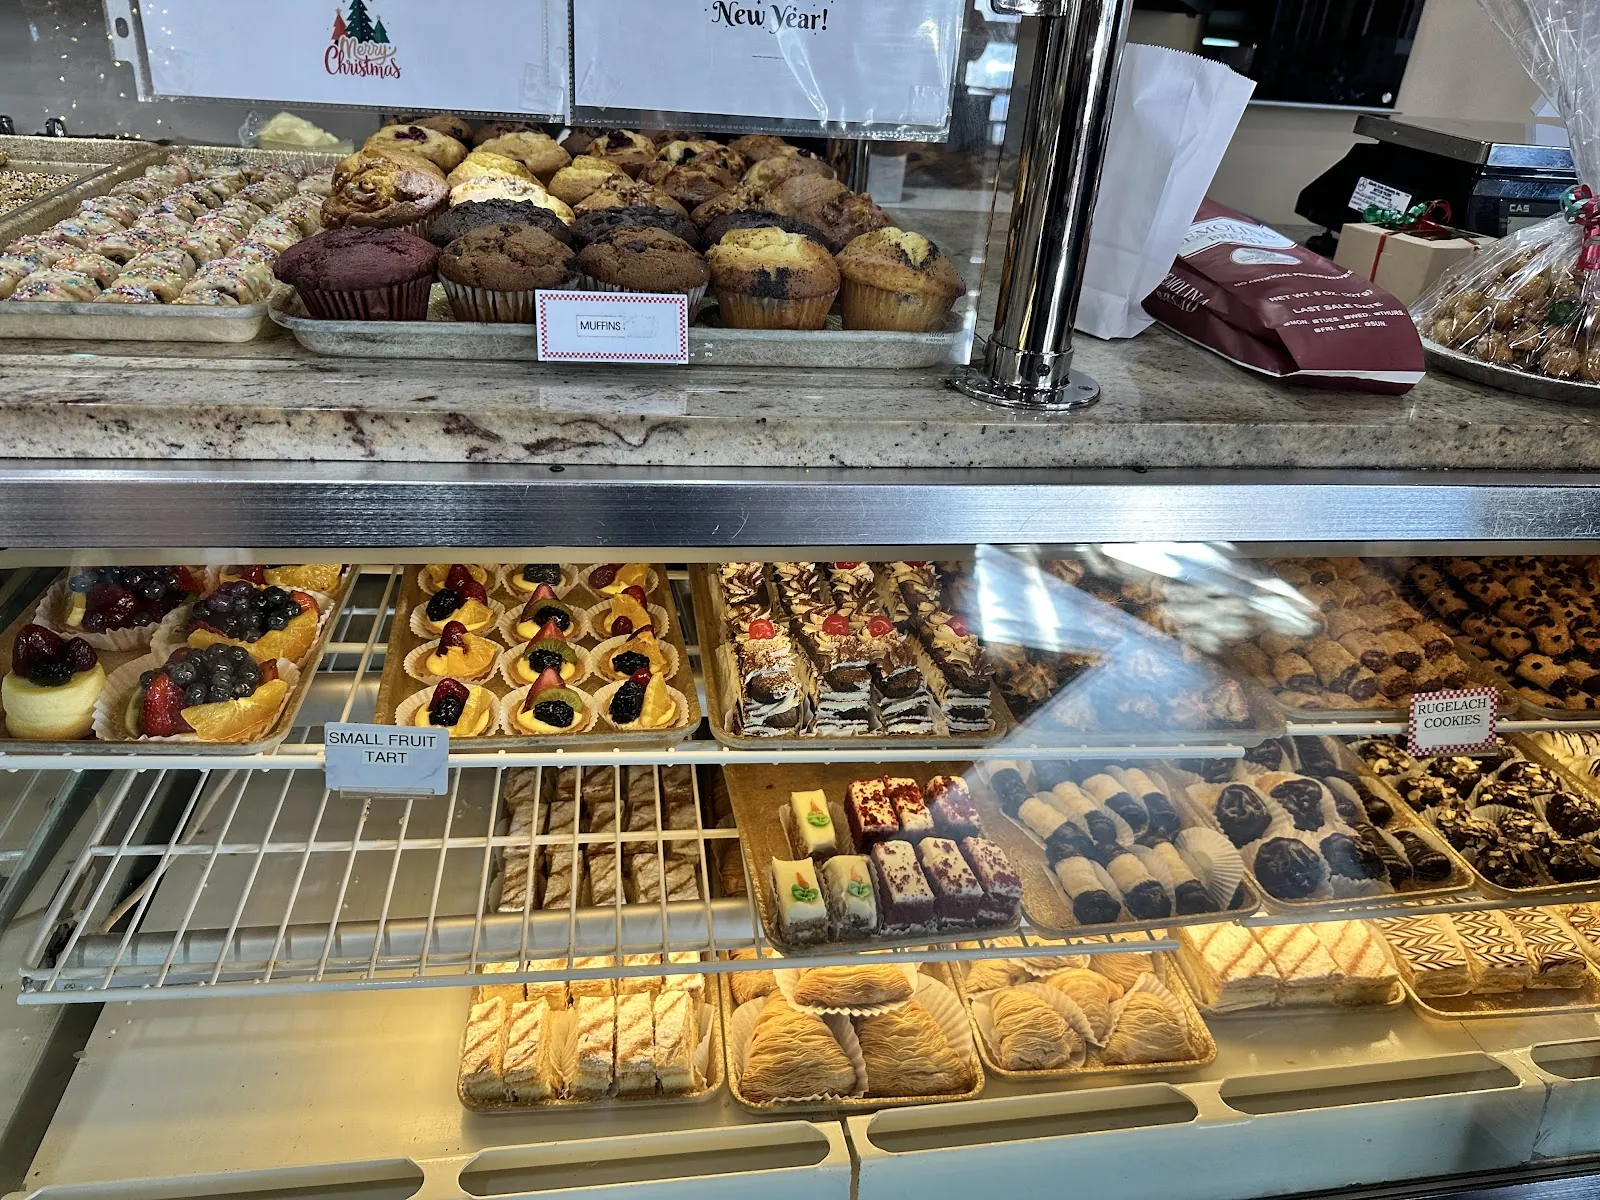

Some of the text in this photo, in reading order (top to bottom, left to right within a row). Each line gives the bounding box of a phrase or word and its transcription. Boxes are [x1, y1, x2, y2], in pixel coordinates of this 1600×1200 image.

[711, 0, 828, 35] New Year!
[339, 35, 397, 65] Merry
[324, 45, 402, 80] Christmas
[1509, 203, 1530, 213] CAS
[1181, 222, 1282, 246] EMOLINA
[1160, 272, 1211, 306] EMOLINA
[1268, 294, 1291, 303] NET
[1292, 291, 1313, 299] WT.
[1292, 304, 1321, 314] LAST
[1323, 302, 1354, 312] SALE
[579, 320, 621, 331] MUFFINS
[1417, 697, 1487, 715] RUGELACH
[1423, 714, 1481, 729] COOKIES
[329, 731, 437, 748] SMALL FRUIT
[364, 750, 408, 764] TART
